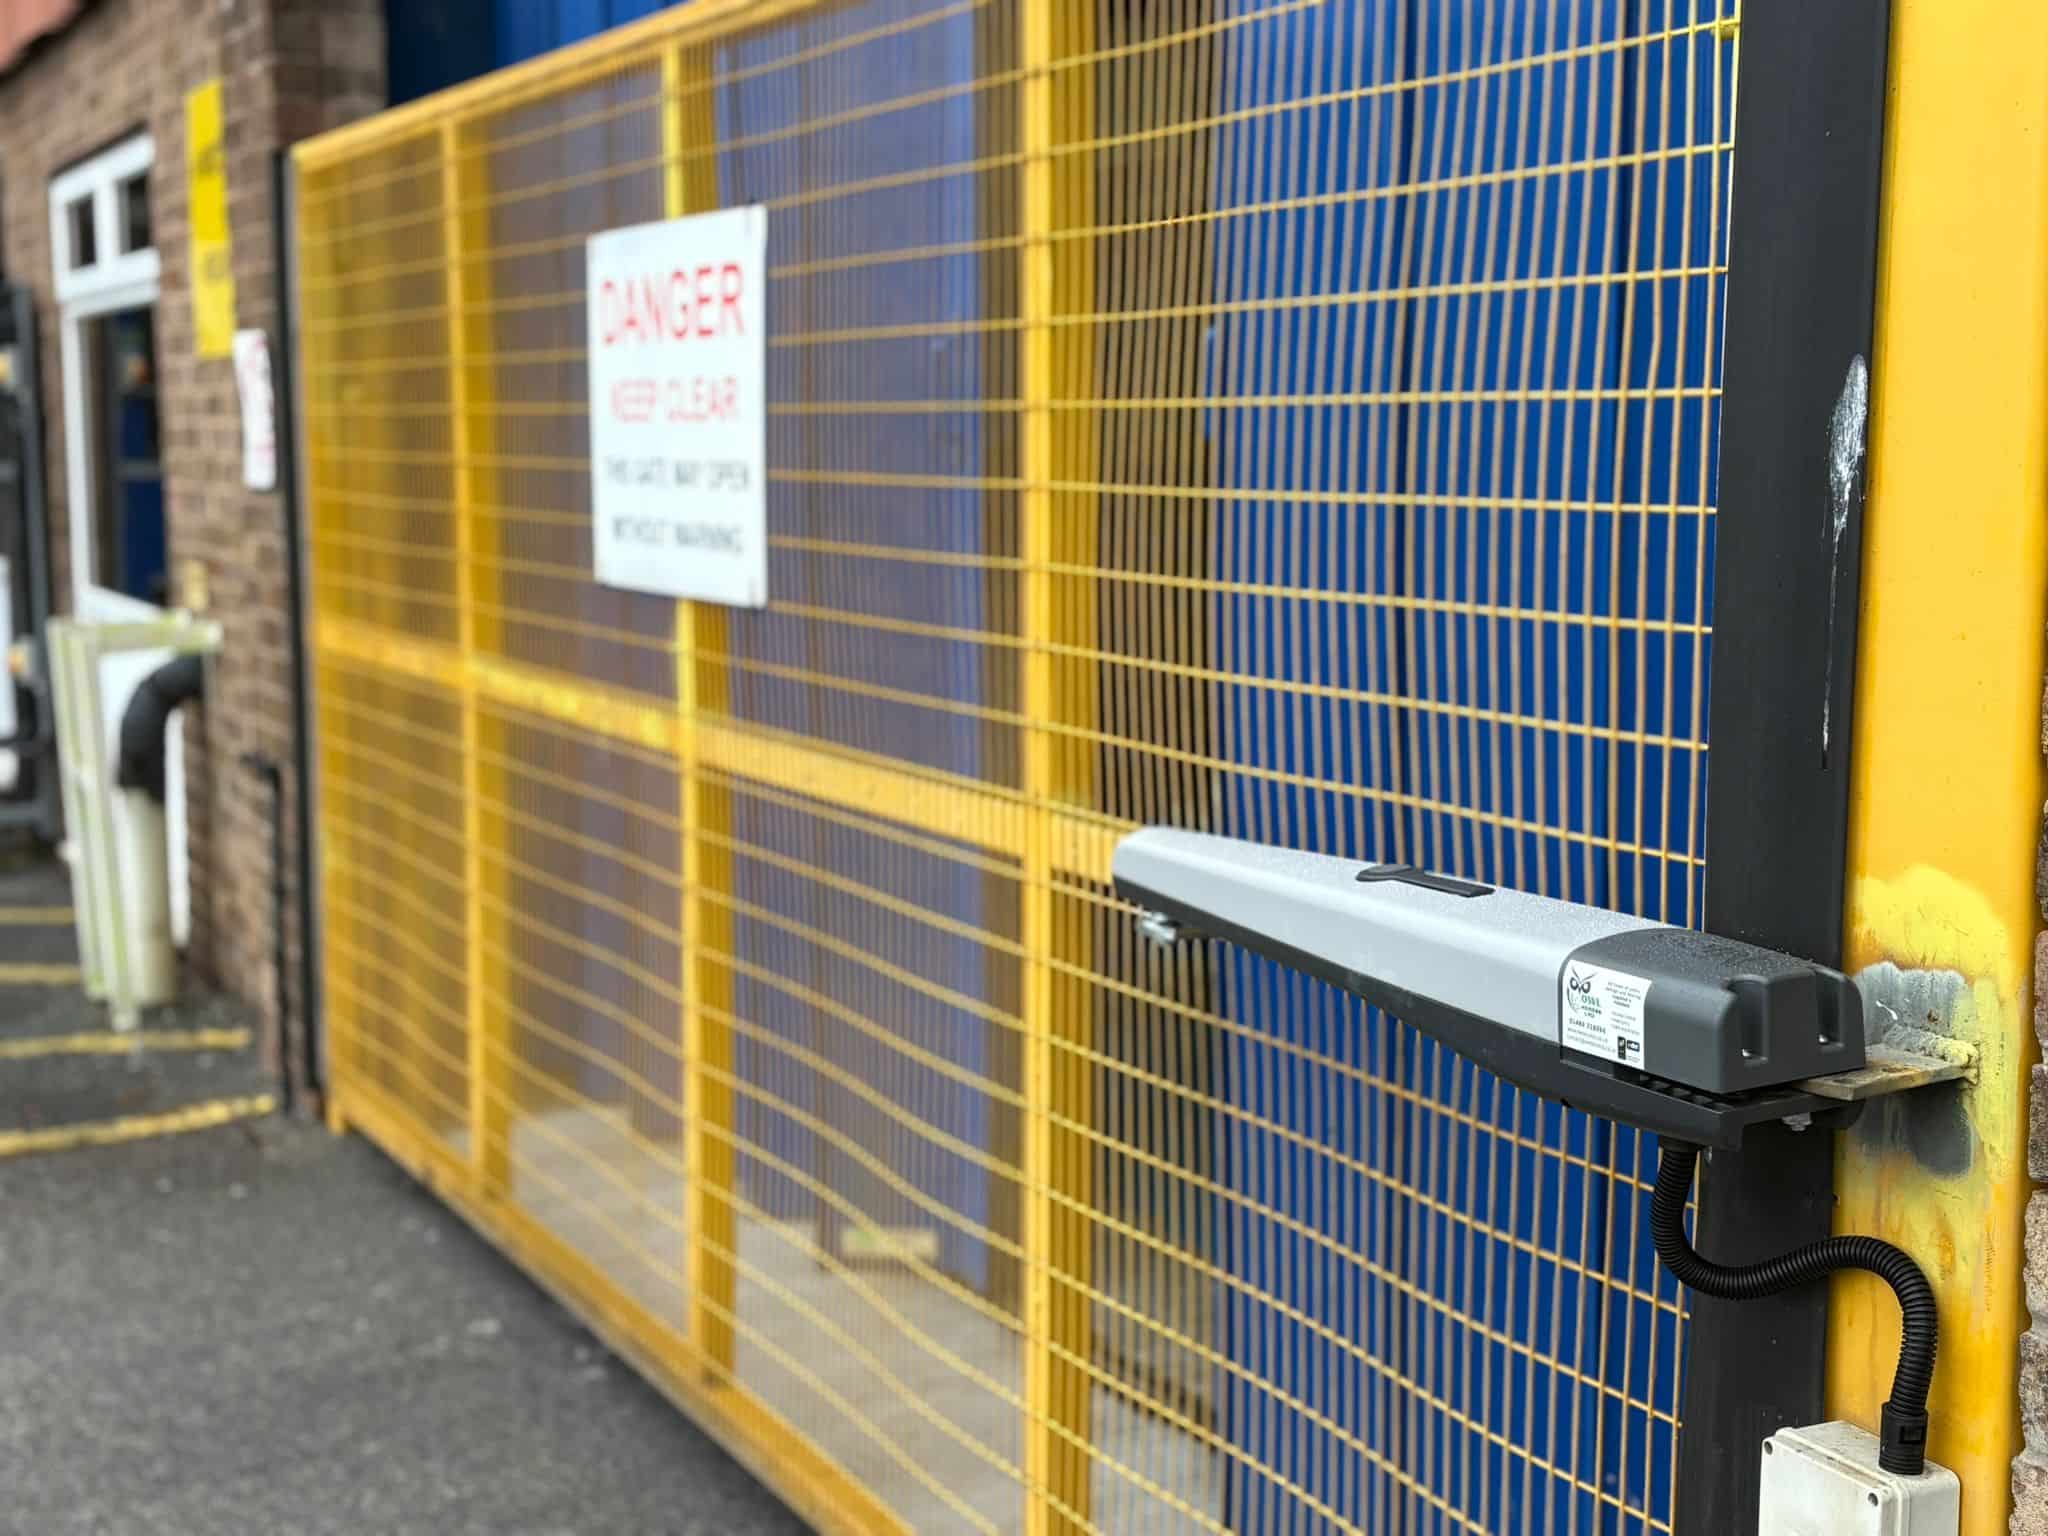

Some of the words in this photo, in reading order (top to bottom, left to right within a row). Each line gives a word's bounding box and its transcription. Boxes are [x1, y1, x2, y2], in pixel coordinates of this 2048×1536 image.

[602, 261, 745, 345] DANGER
[610, 377, 657, 423] KEEP
[666, 374, 740, 422] CLEAR
